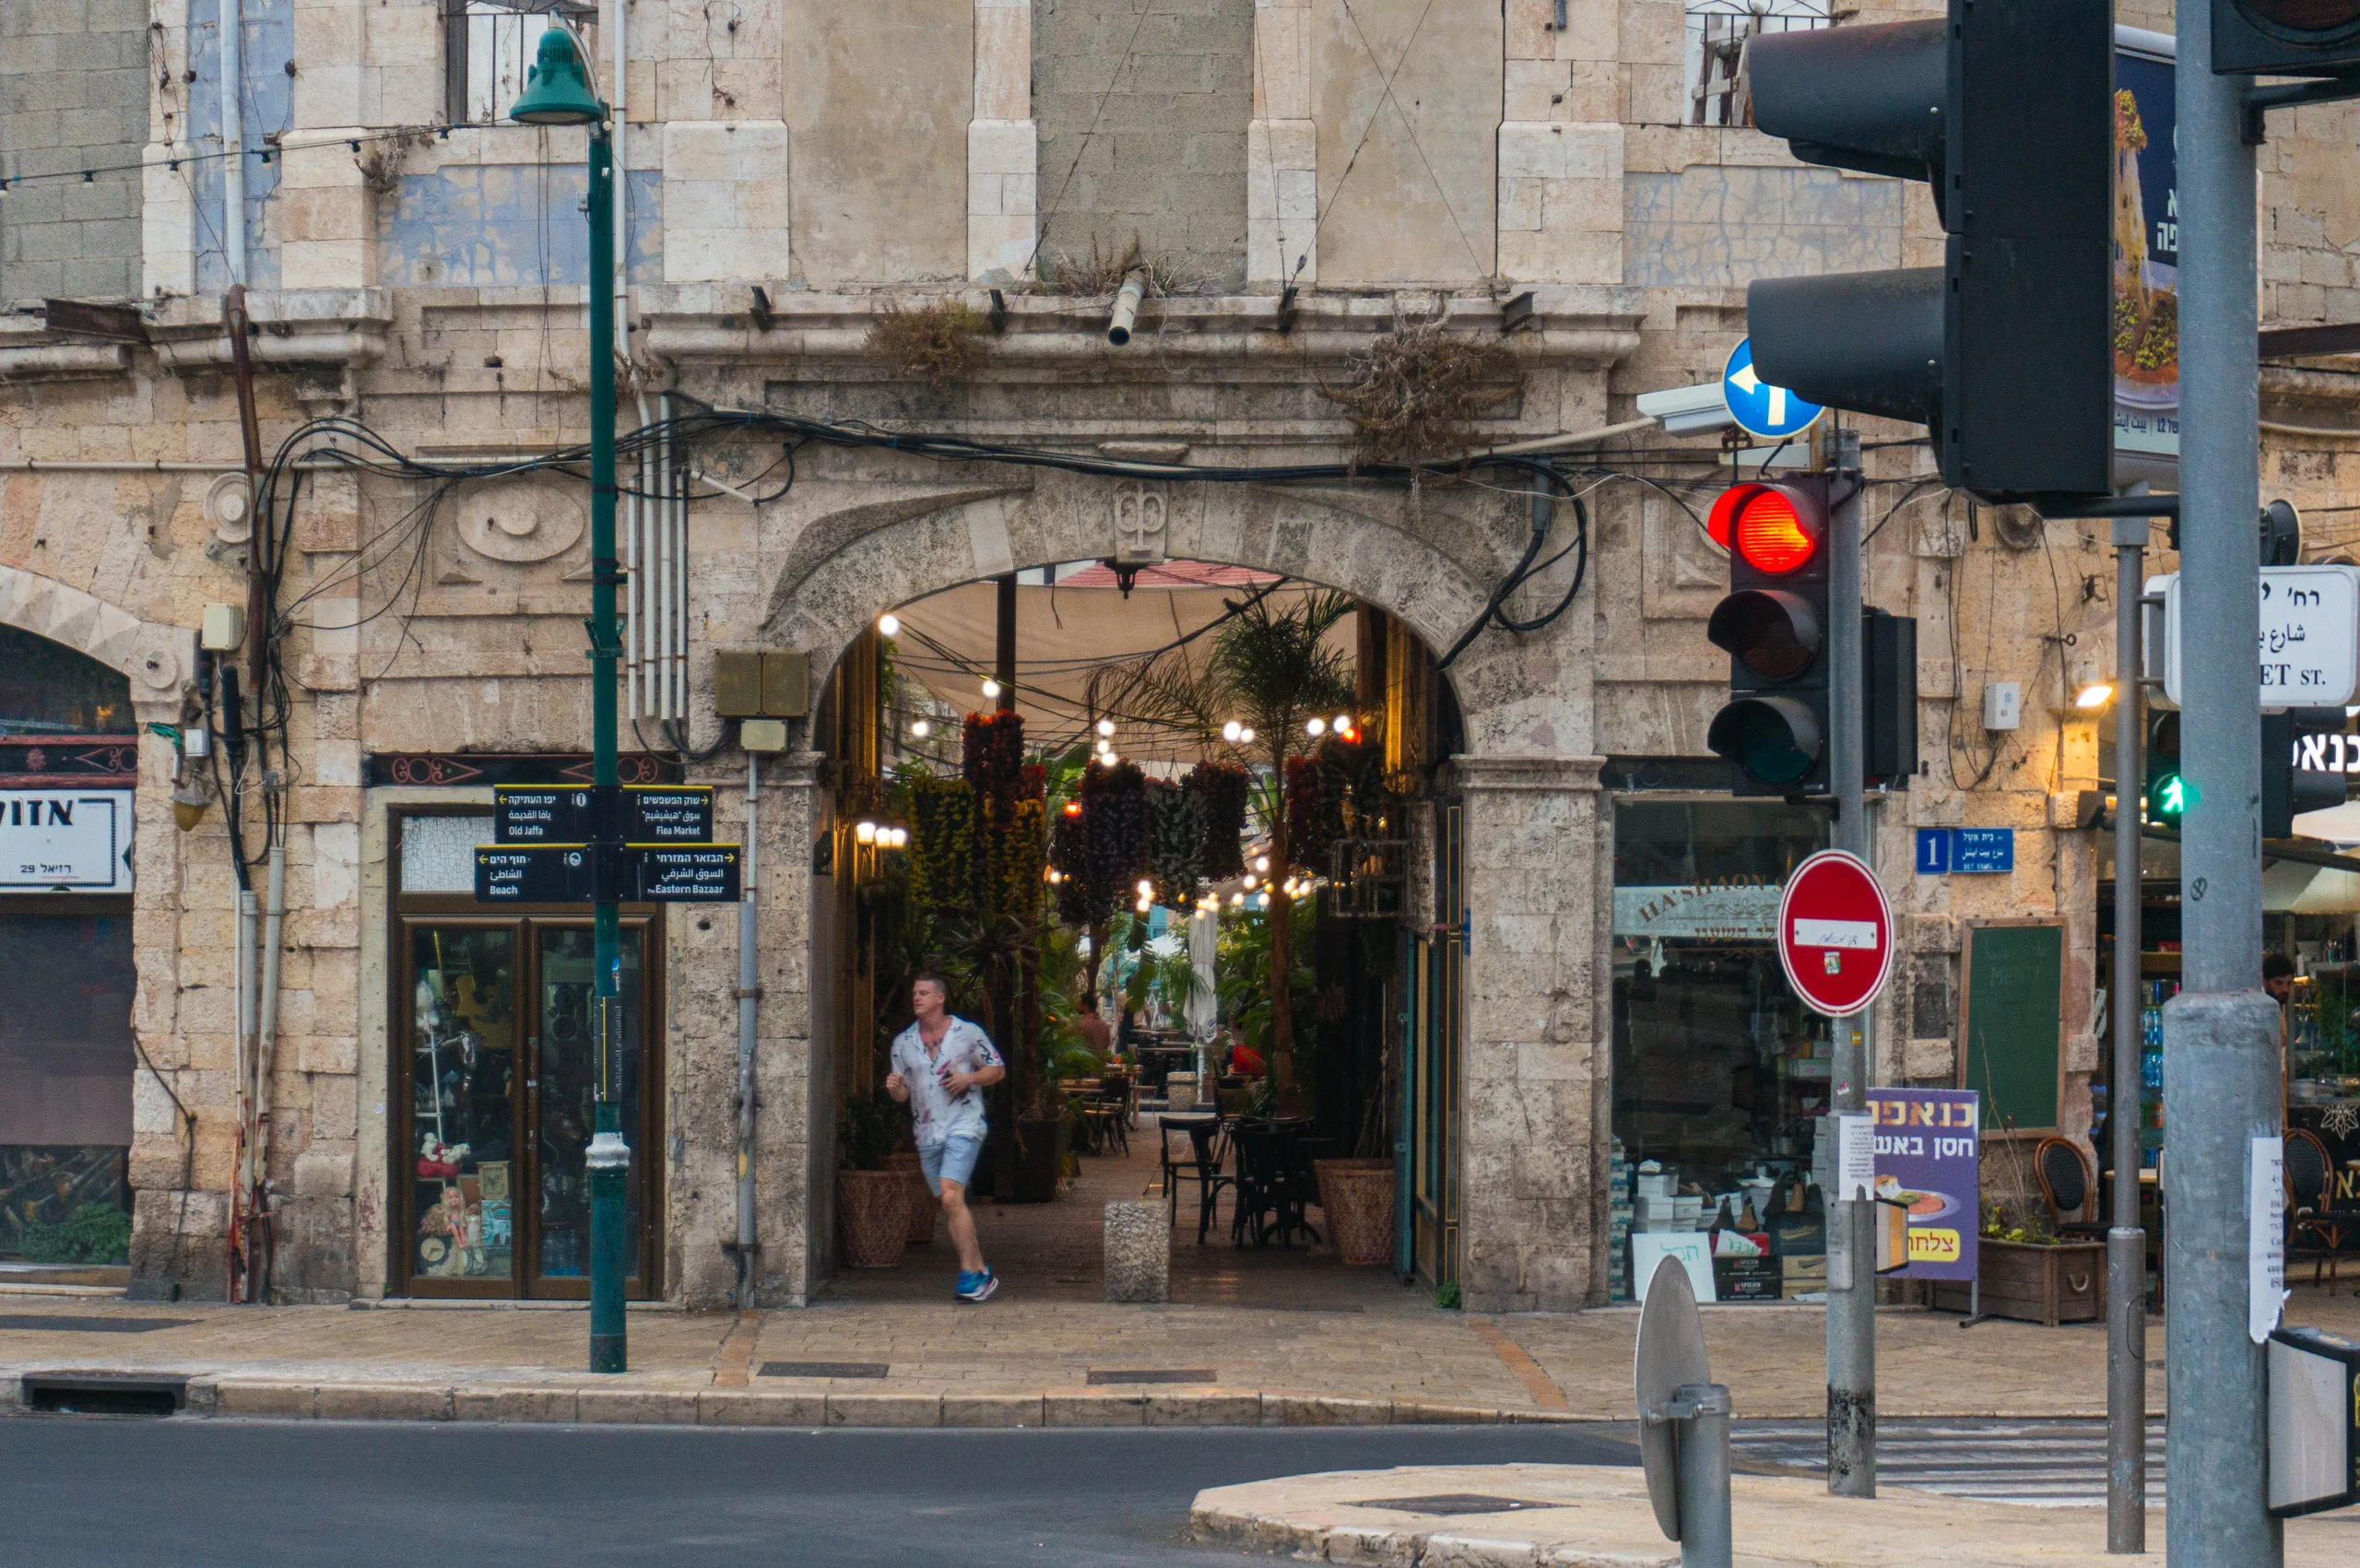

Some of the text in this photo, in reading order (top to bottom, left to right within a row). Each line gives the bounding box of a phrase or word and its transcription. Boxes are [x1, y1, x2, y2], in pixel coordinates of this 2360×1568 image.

[2270, 623, 2306, 654] شارع
[2260, 664, 2326, 685] ET ST.
[2292, 733, 2360, 772] כנא
[508, 796, 556, 805] יפו העתיקה
[643, 796, 682, 805] הפשפשים
[684, 796, 700, 806] שוק
[683, 811, 701, 822] سوق
[509, 826, 543, 835] Old Jaffa
[656, 826, 701, 835] Flea Market
[1927, 837, 1939, 866] 1
[490, 855, 526, 865] חוף הים
[656, 854, 691, 863] המזרחי
[694, 854, 724, 863] הבזאר
[20, 863, 72, 873] רזיאל 29
[661, 867, 724, 881] السوق الشرقي
[490, 885, 518, 894] Beach
[655, 885, 690, 893] Eastern
[692, 885, 724, 894] Bazaar
[1639, 874, 1766, 922] HA'SHAON
[1934, 1137, 1974, 1160] חסן
